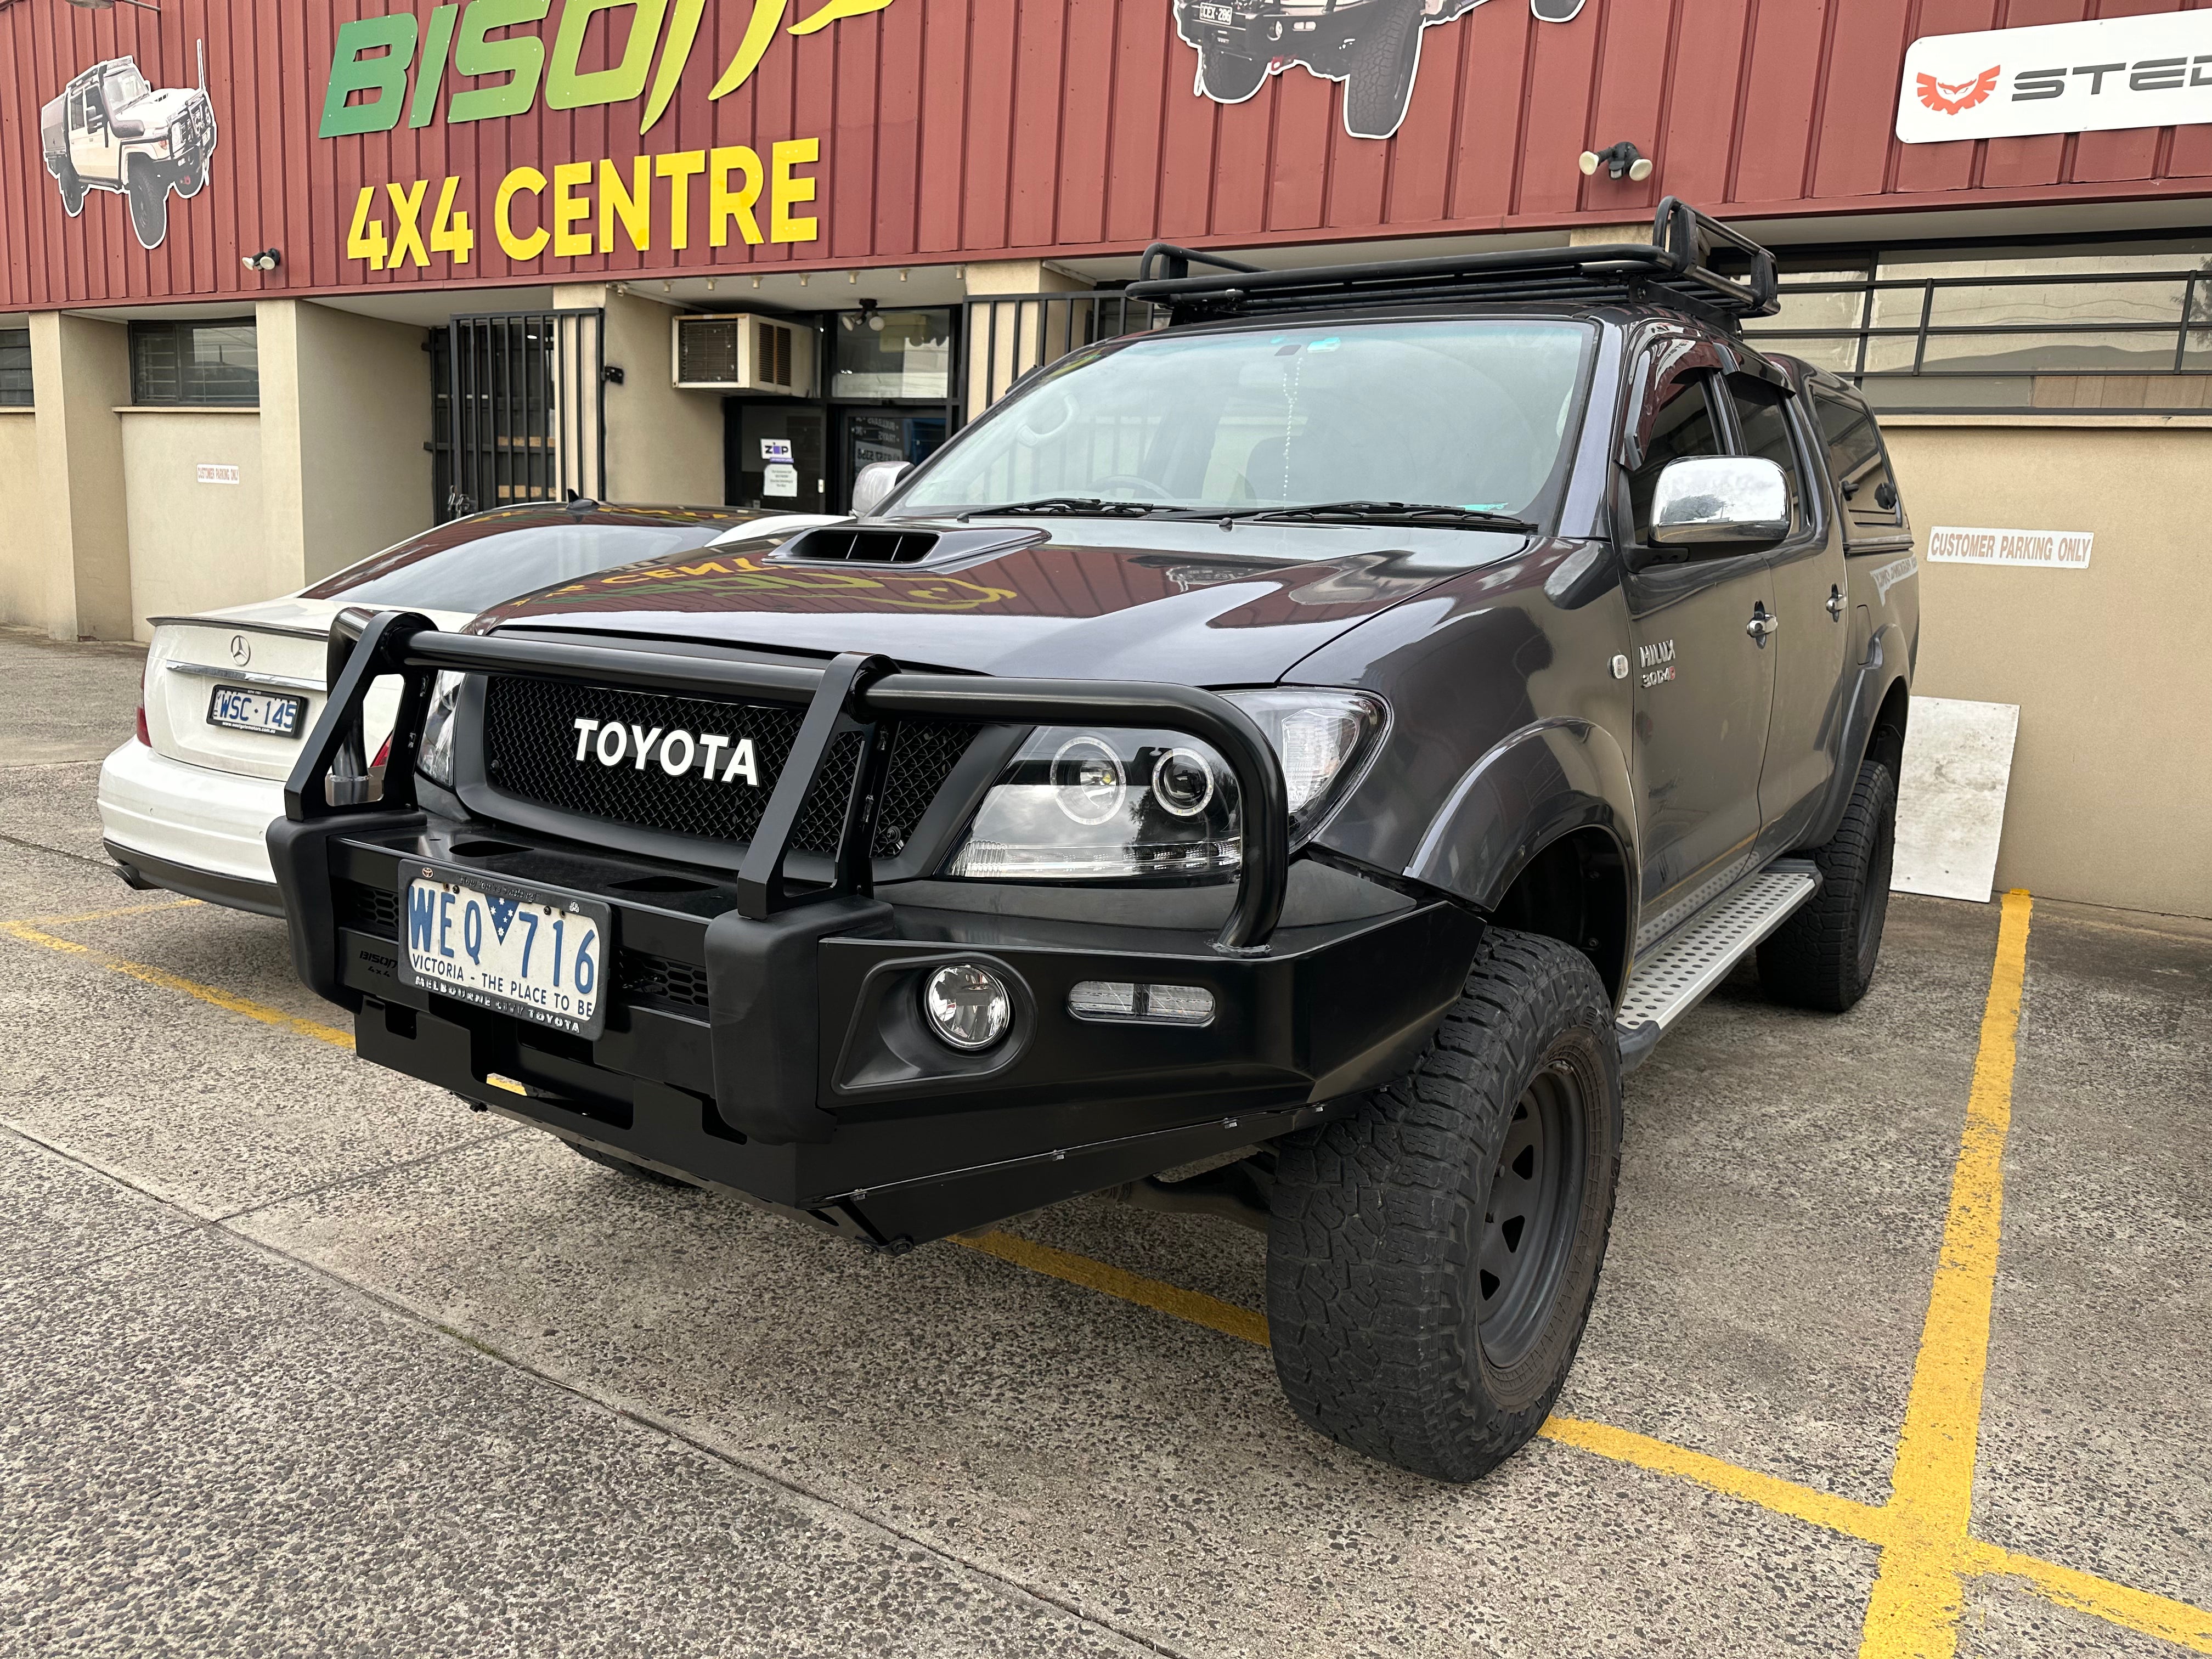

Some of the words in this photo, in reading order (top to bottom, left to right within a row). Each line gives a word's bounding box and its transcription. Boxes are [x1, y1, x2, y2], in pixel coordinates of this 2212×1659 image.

[347, 176, 473, 270] 4X4
[494, 137, 819, 261] CENTRE
[1931, 532, 1995, 558] CUSTOMER
[2000, 536, 2053, 560] PARKING
[2058, 538, 2091, 562] ONLY
[1639, 639, 1675, 668] HILUX
[220, 693, 252, 721] WSC
[264, 701, 297, 729] 145
[574, 718, 759, 786] TOYOTA
[359, 950, 398, 969] BISON
[408, 884, 482, 966] WEQ
[518, 911, 596, 994] 716
[413, 953, 464, 981] VICTORIA
[482, 973, 503, 992] THE
[511, 981, 546, 1005] PLACE
[554, 994, 569, 1011] TO
[578, 1002, 592, 1018] BE
[415, 975, 491, 1007] MELBOURNE
[495, 1000, 524, 1015] CITY
[527, 1008, 580, 1034] TOYOTA
